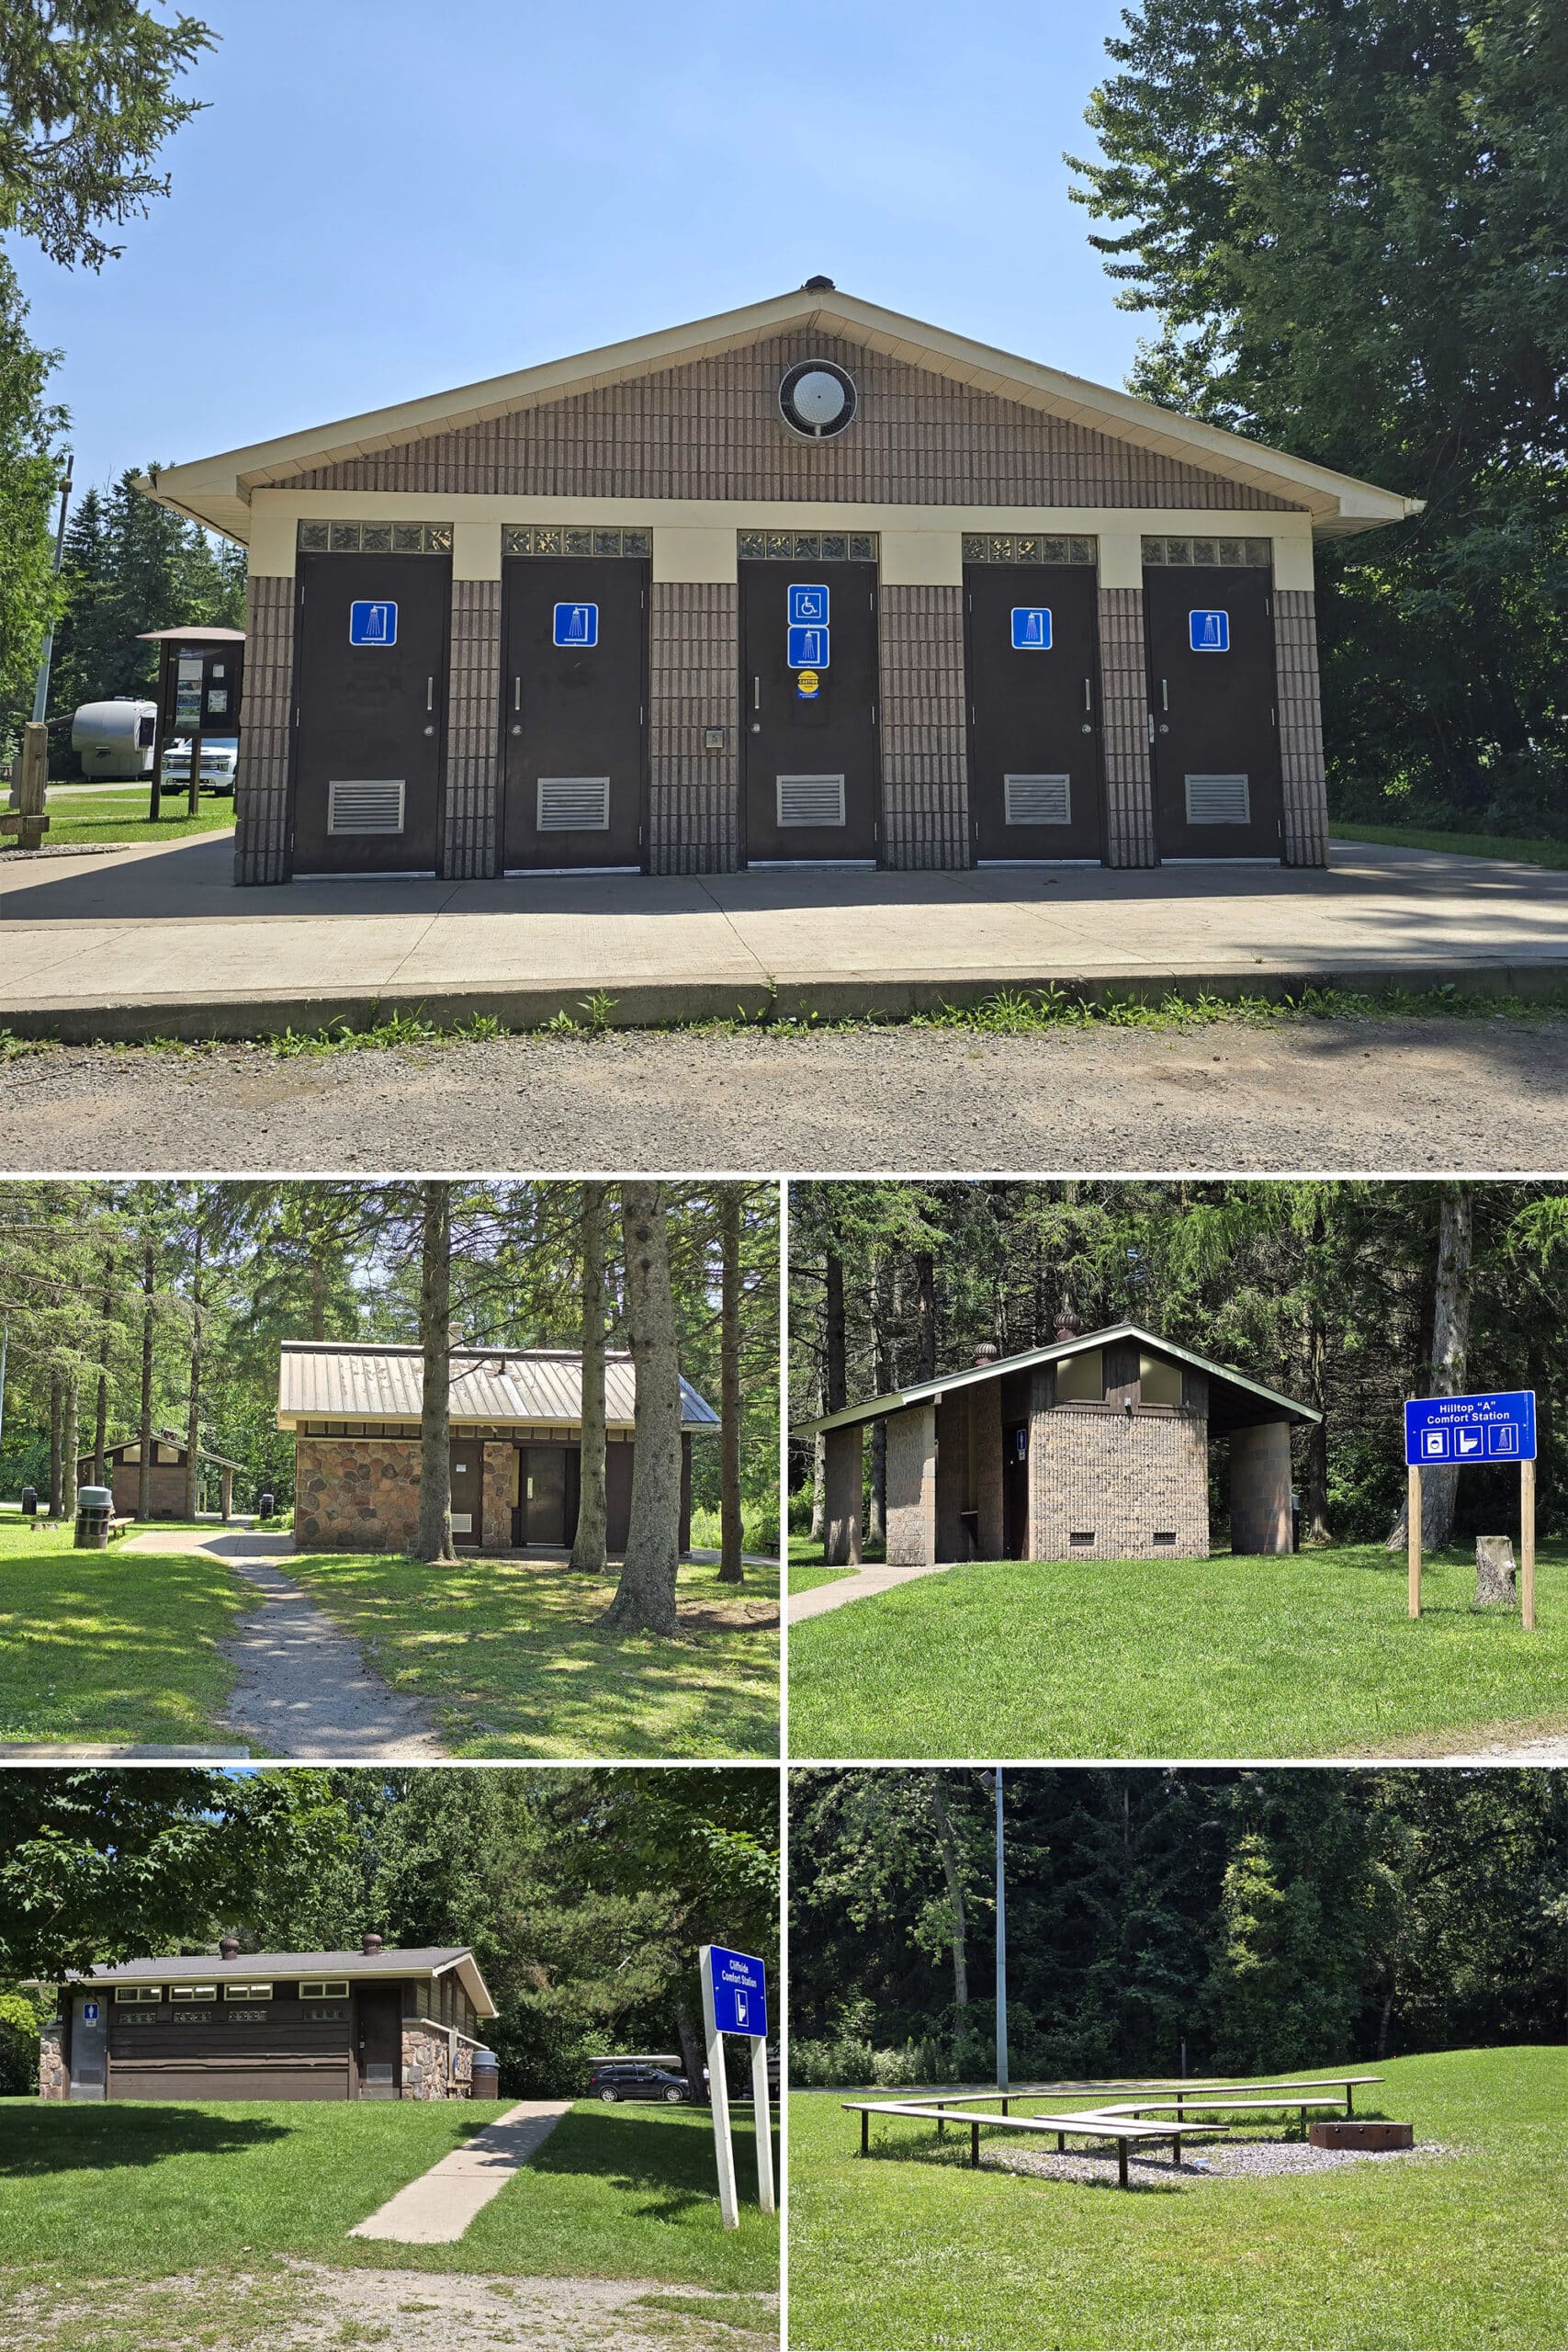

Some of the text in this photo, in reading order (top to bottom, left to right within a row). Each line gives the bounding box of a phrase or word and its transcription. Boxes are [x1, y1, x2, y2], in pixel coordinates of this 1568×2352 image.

[1440, 1404, 1473, 1413] Hilltop
[1427, 1411, 1510, 1424] Comfort Station
[729, 1960, 749, 1973] Cliffside
[722, 1970, 757, 1987] Comfort Station
